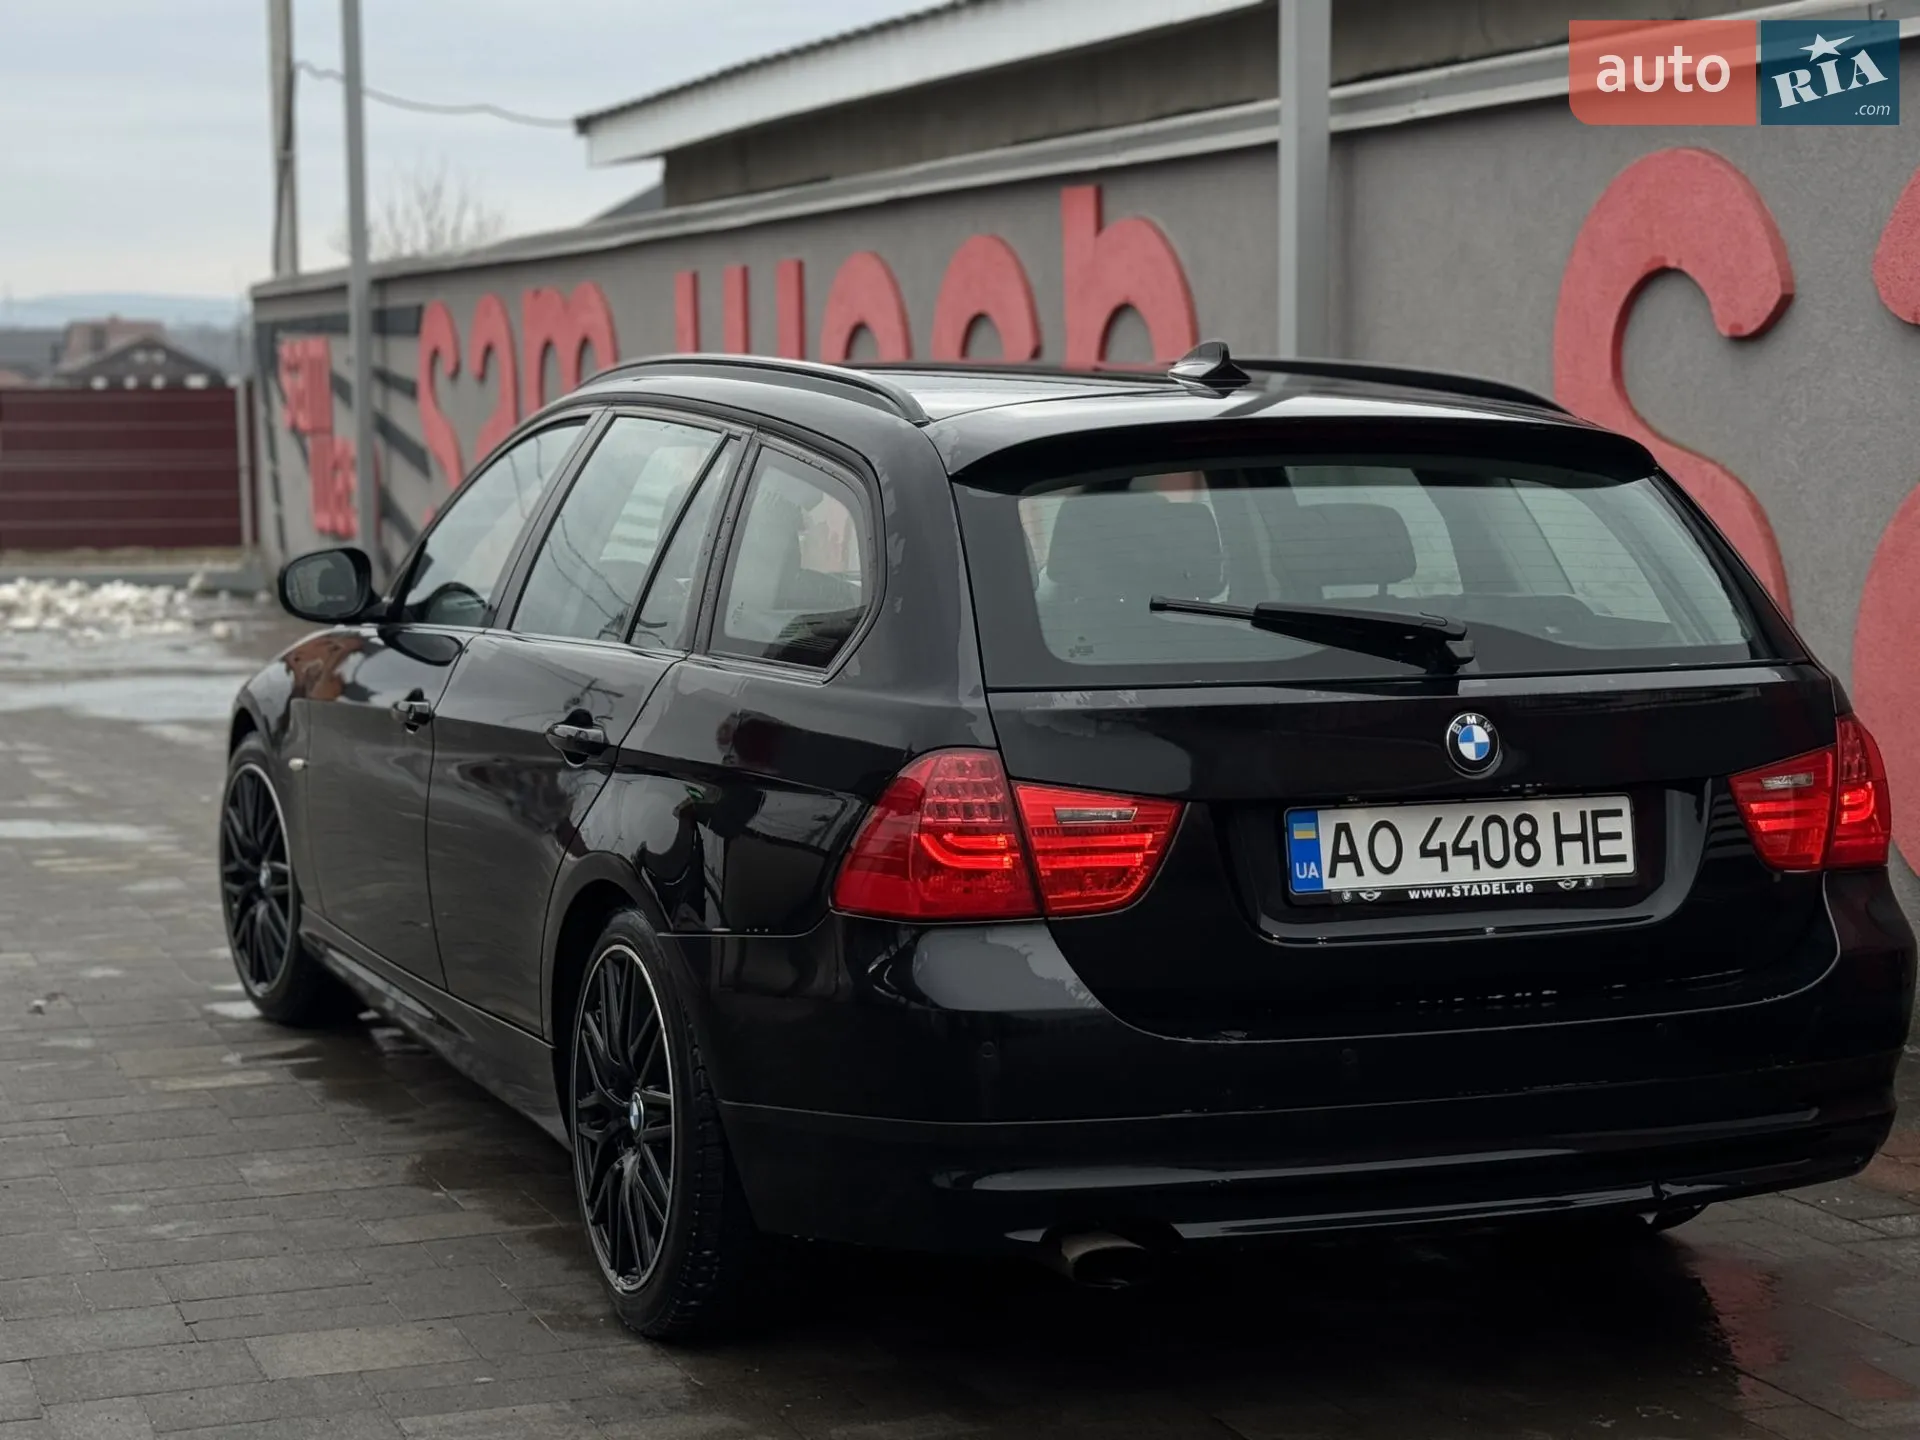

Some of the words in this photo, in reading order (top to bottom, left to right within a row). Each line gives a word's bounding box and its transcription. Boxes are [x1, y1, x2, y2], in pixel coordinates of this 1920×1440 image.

[1451, 715, 1493, 735] BMW
[1328, 819, 1404, 879] AO
[1419, 812, 1542, 873] 4408
[1552, 808, 1628, 866] HE
[1295, 861, 1320, 880] UA
[1408, 881, 1534, 900] www.STADEL.de
